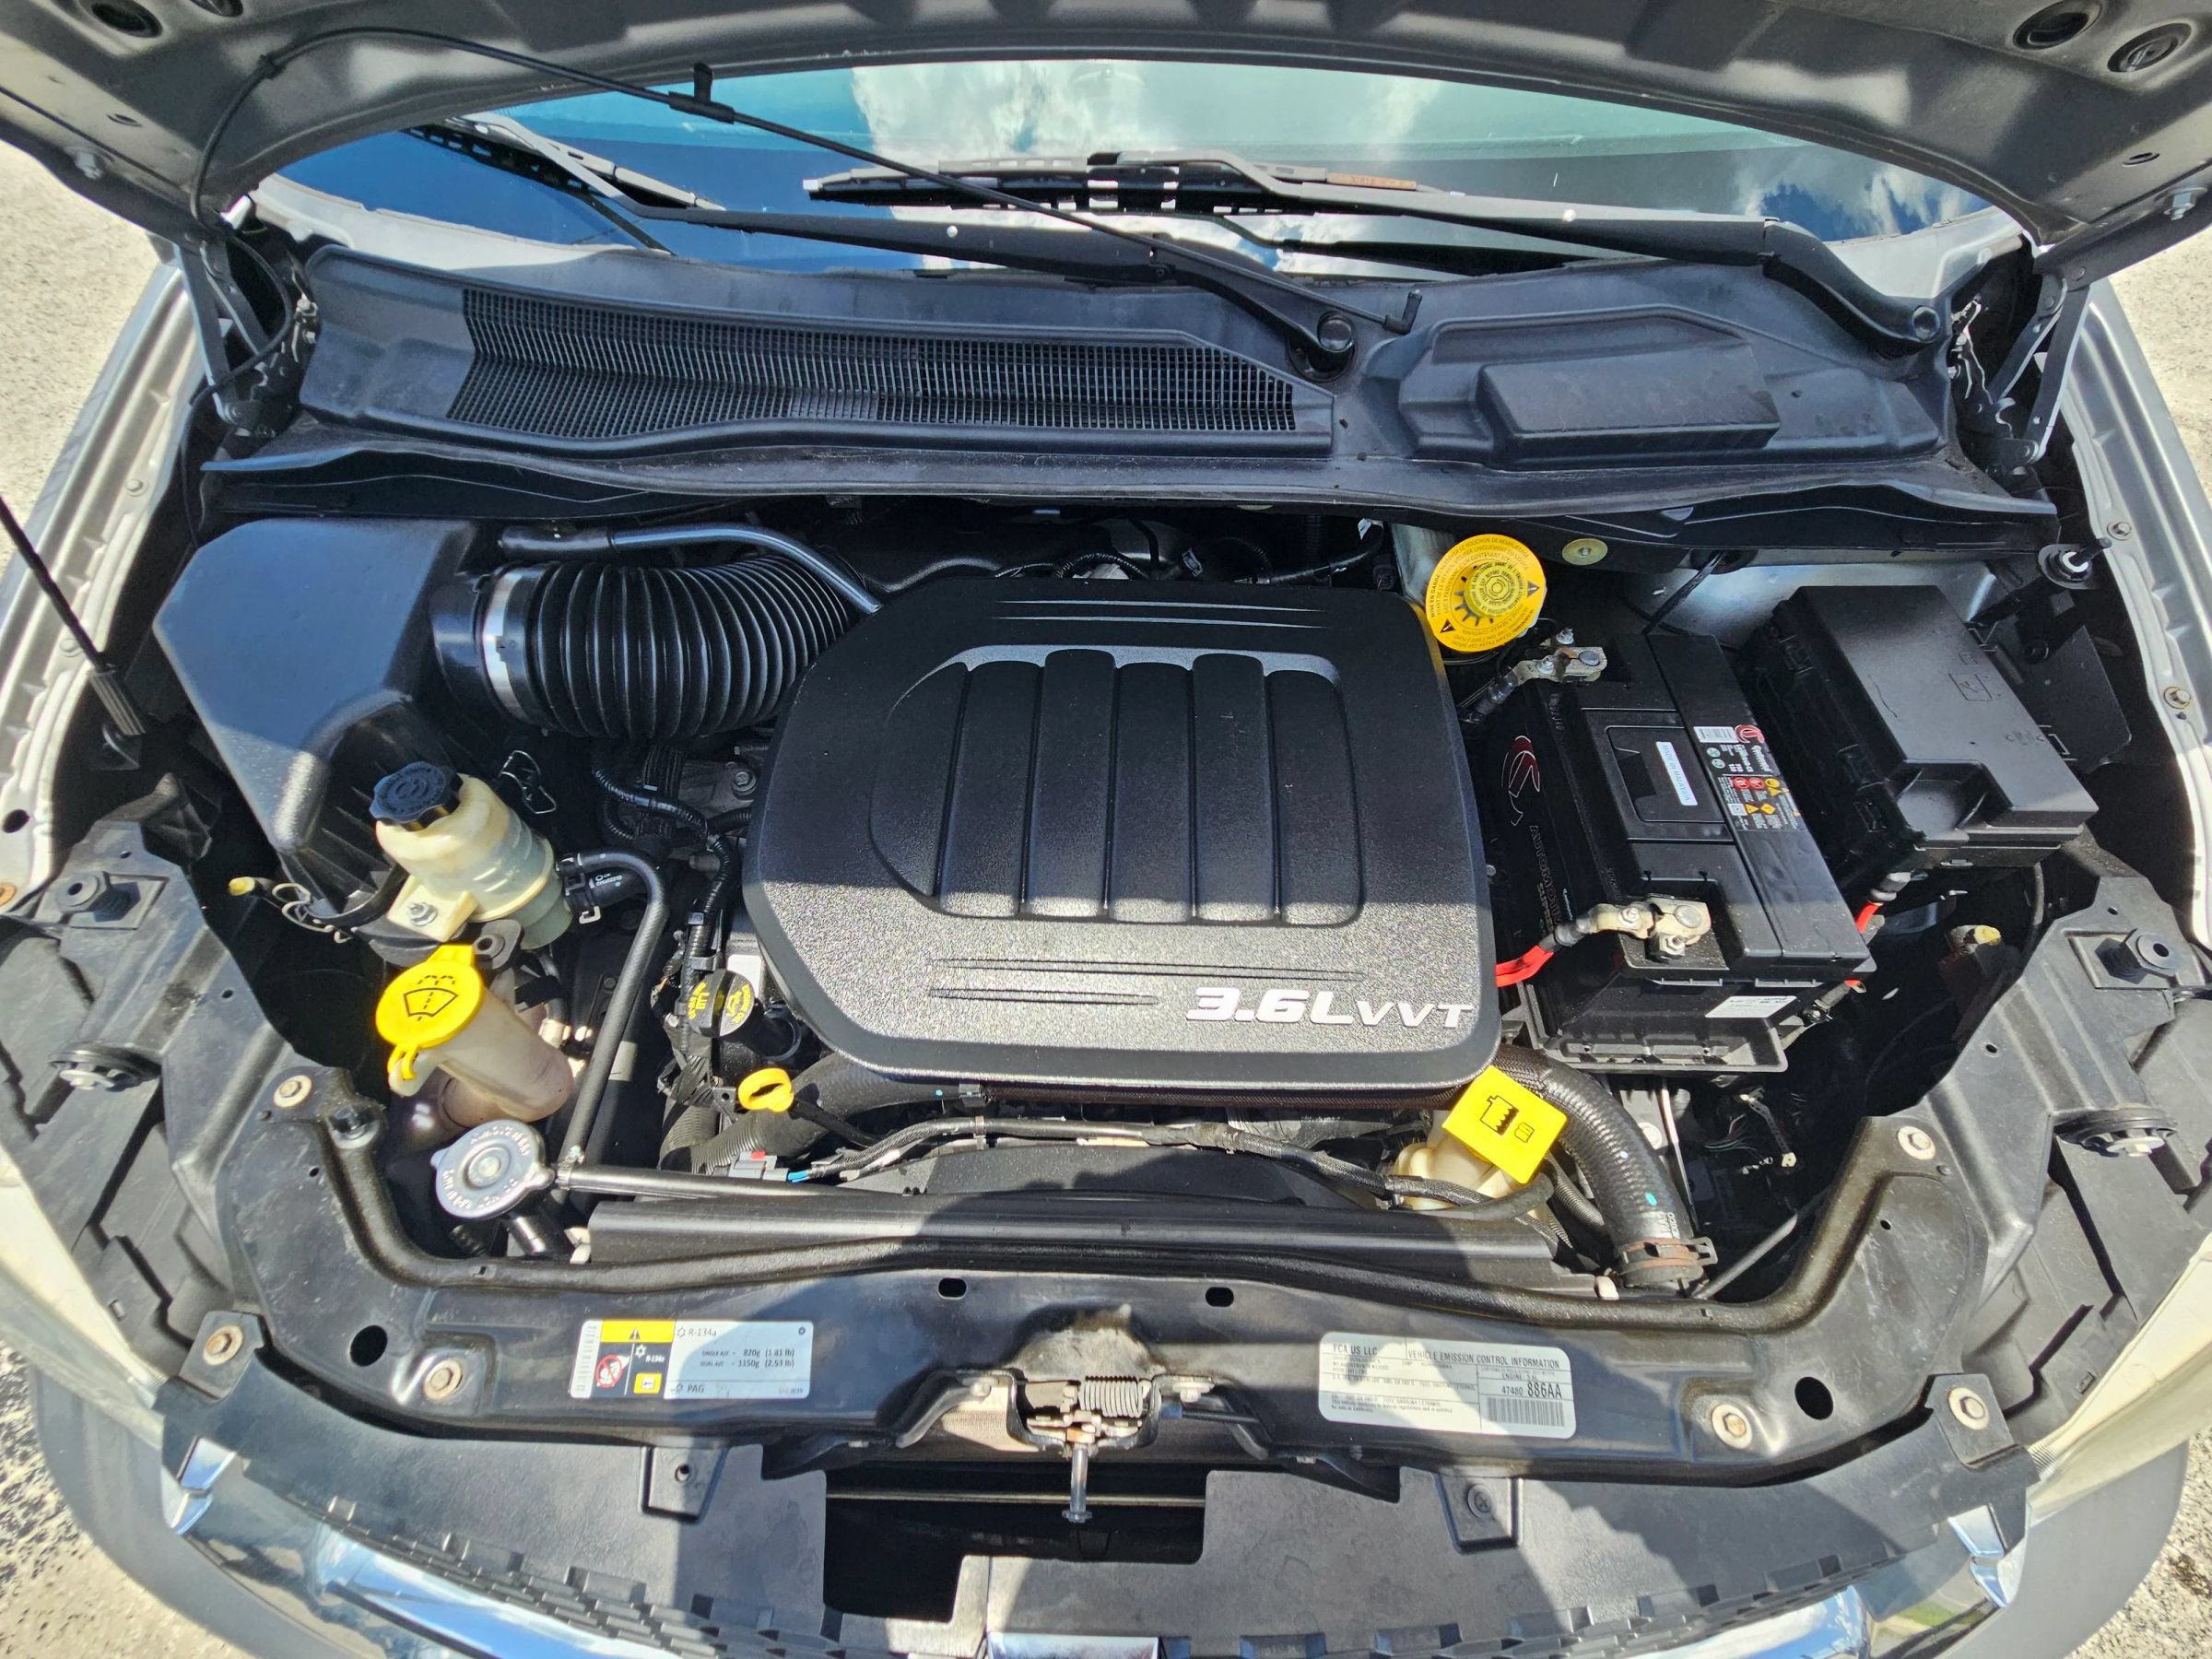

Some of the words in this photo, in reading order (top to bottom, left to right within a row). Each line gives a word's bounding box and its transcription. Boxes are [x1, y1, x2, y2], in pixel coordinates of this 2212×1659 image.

[1356, 1000, 1474, 1029] VVT
[1350, 1346, 1362, 1355] US
[1363, 1347, 1378, 1357] LLC
[1407, 1349, 1438, 1361] VEHICLE
[1440, 1352, 1475, 1364] EMISSION
[1477, 1355, 1509, 1366] CONTROL
[1511, 1358, 1560, 1370] INFORMATION
[687, 1384, 705, 1394] PAG
[1527, 1382, 1562, 1399] 886AA
